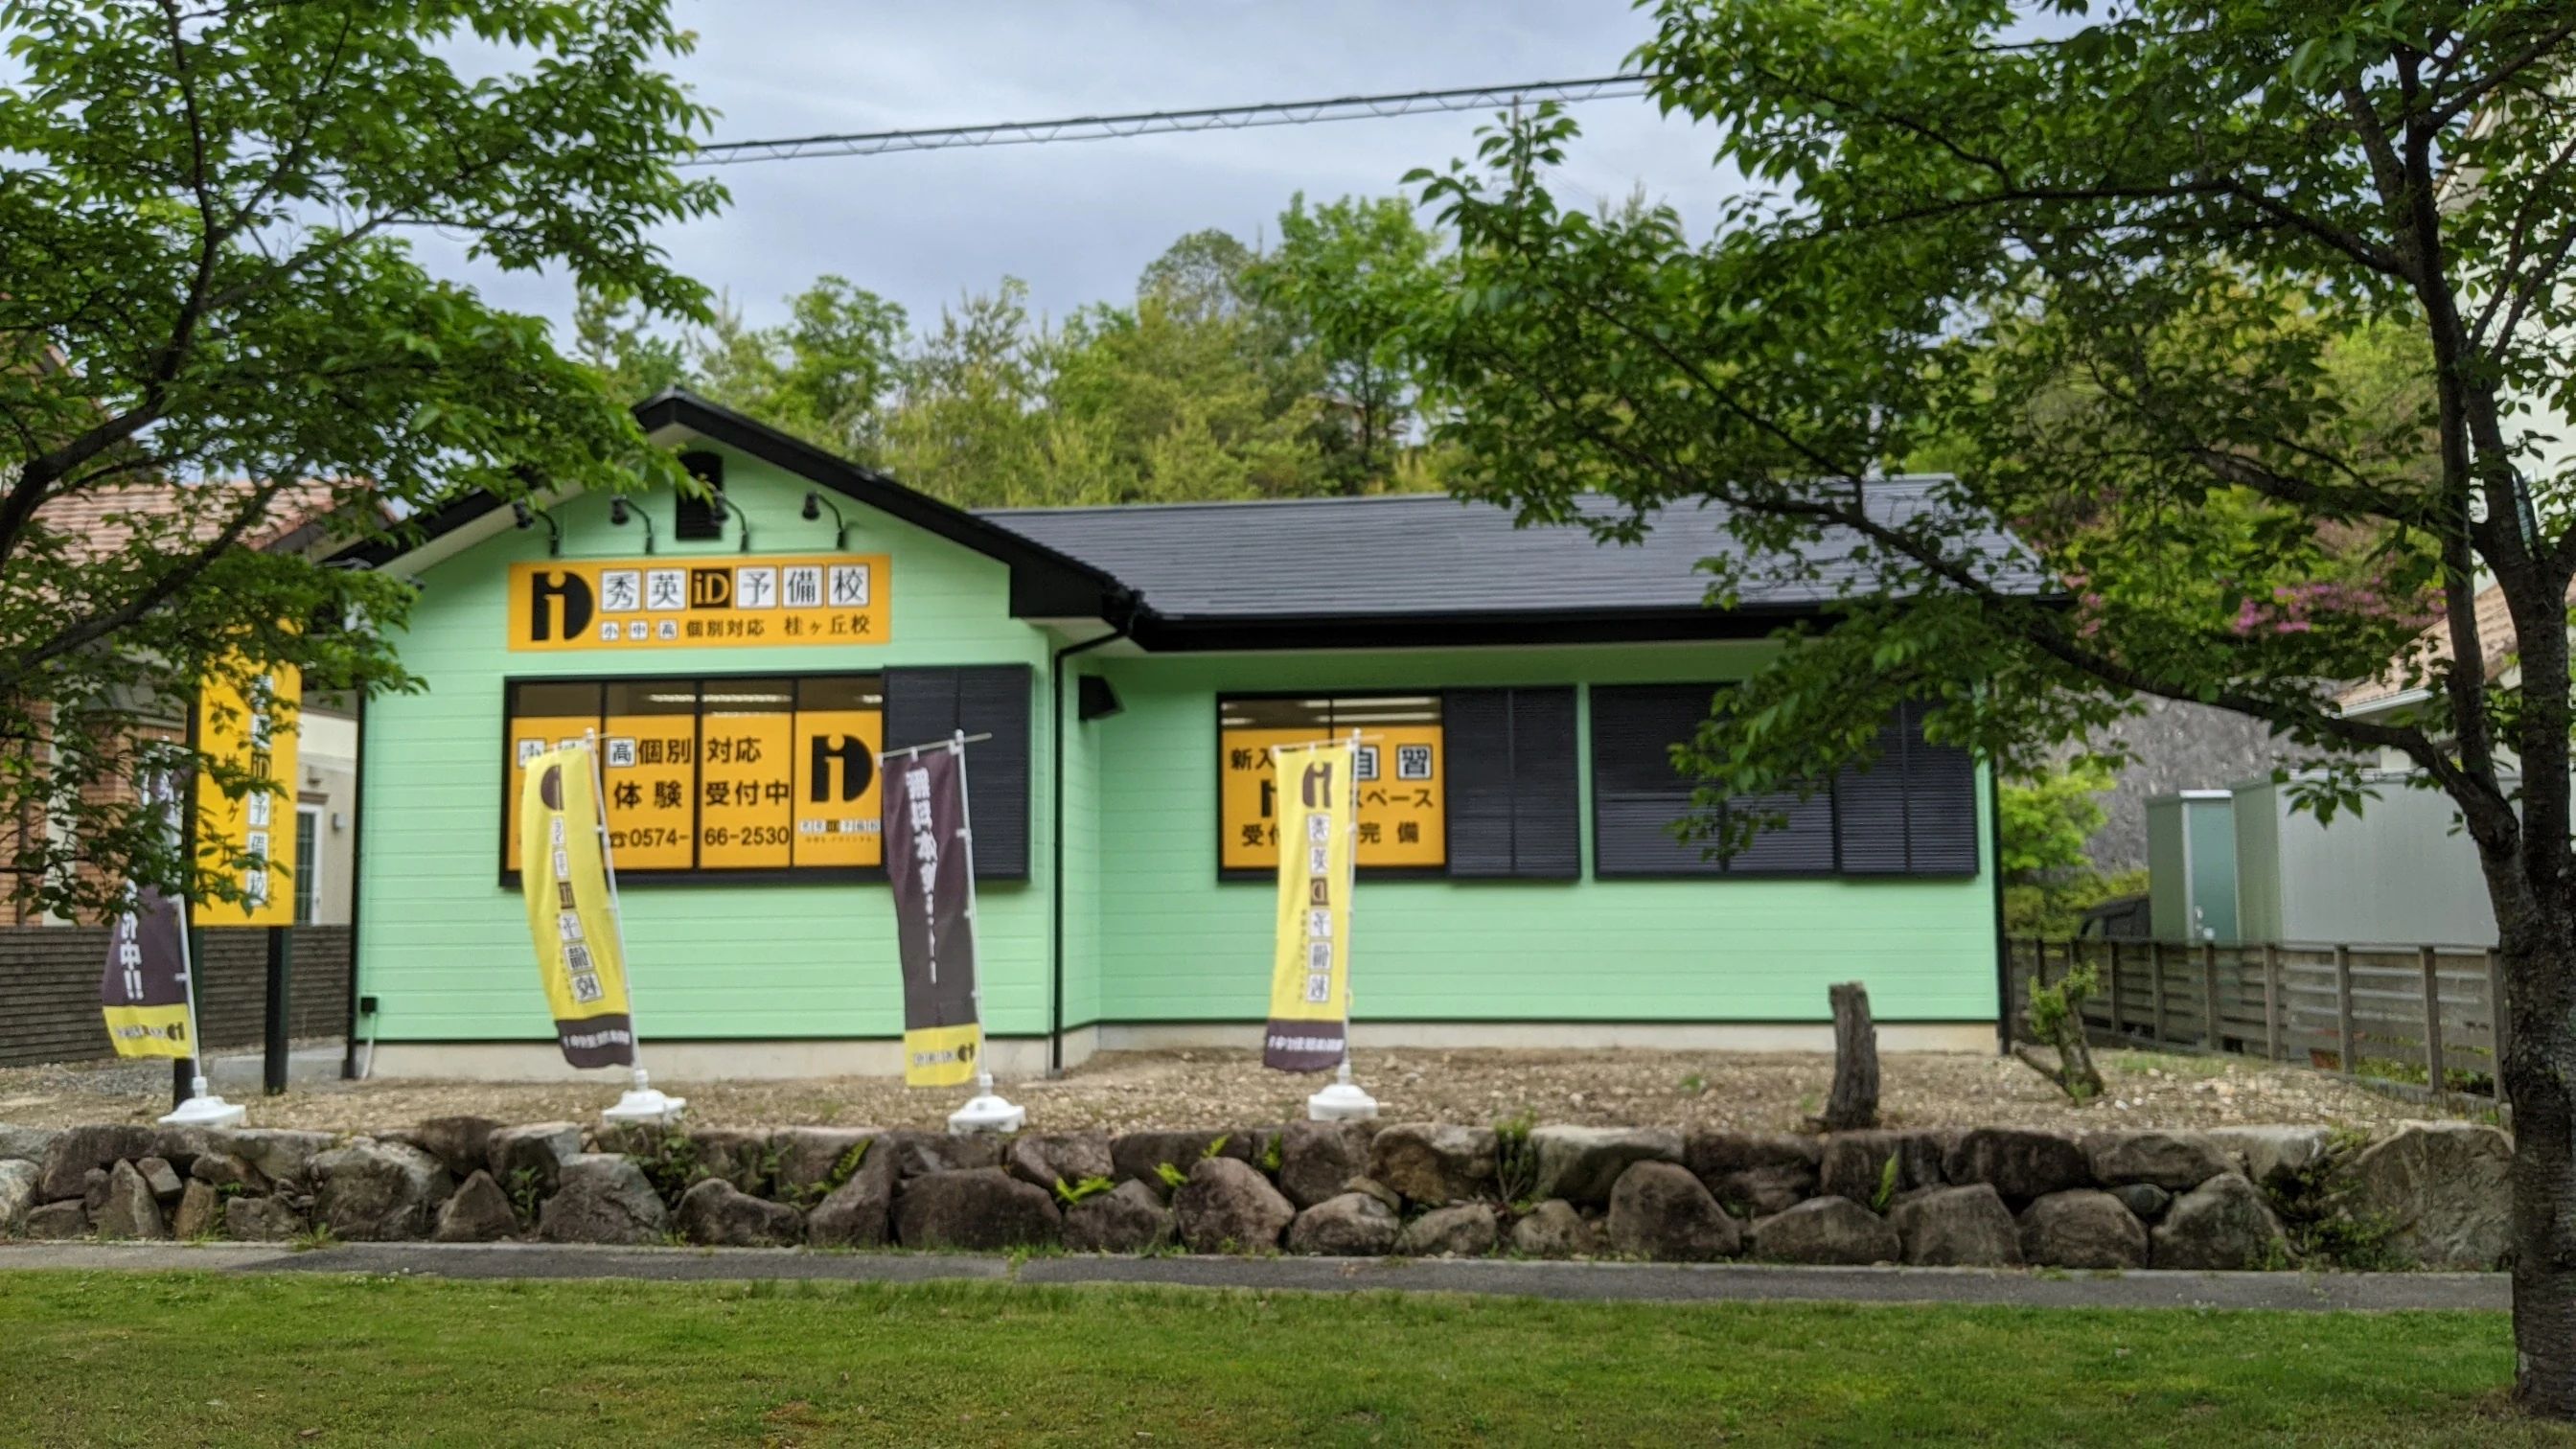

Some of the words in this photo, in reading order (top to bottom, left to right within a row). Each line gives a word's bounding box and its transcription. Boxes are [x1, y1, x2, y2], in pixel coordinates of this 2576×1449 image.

[604, 567, 866, 610] 秀英iD予備校
[686, 619, 766, 638] 個別対応
